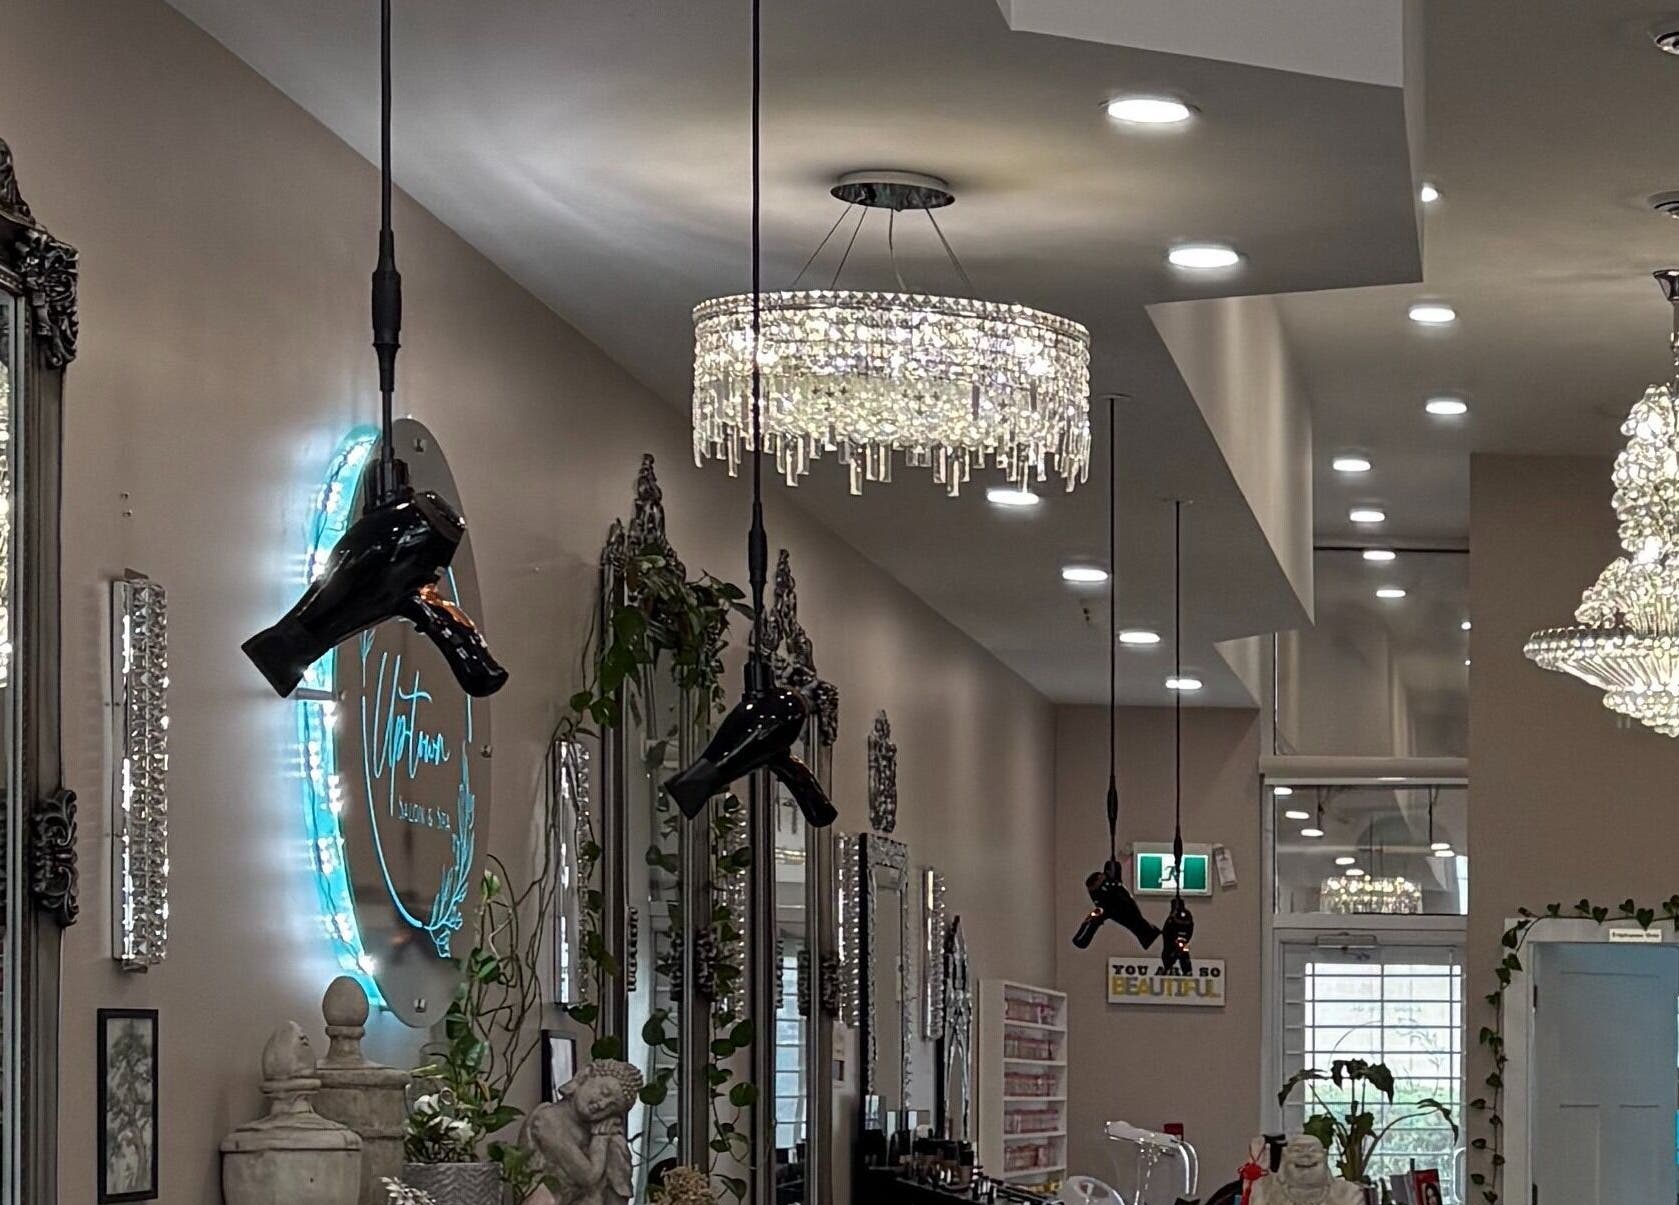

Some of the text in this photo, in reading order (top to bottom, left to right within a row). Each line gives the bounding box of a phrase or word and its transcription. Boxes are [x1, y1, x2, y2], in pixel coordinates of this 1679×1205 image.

[373, 652, 450, 816] Uptown
[1112, 964, 1149, 976] YOU
[1199, 967, 1221, 977] SO
[1111, 976, 1222, 999] BEAUTIFUL
